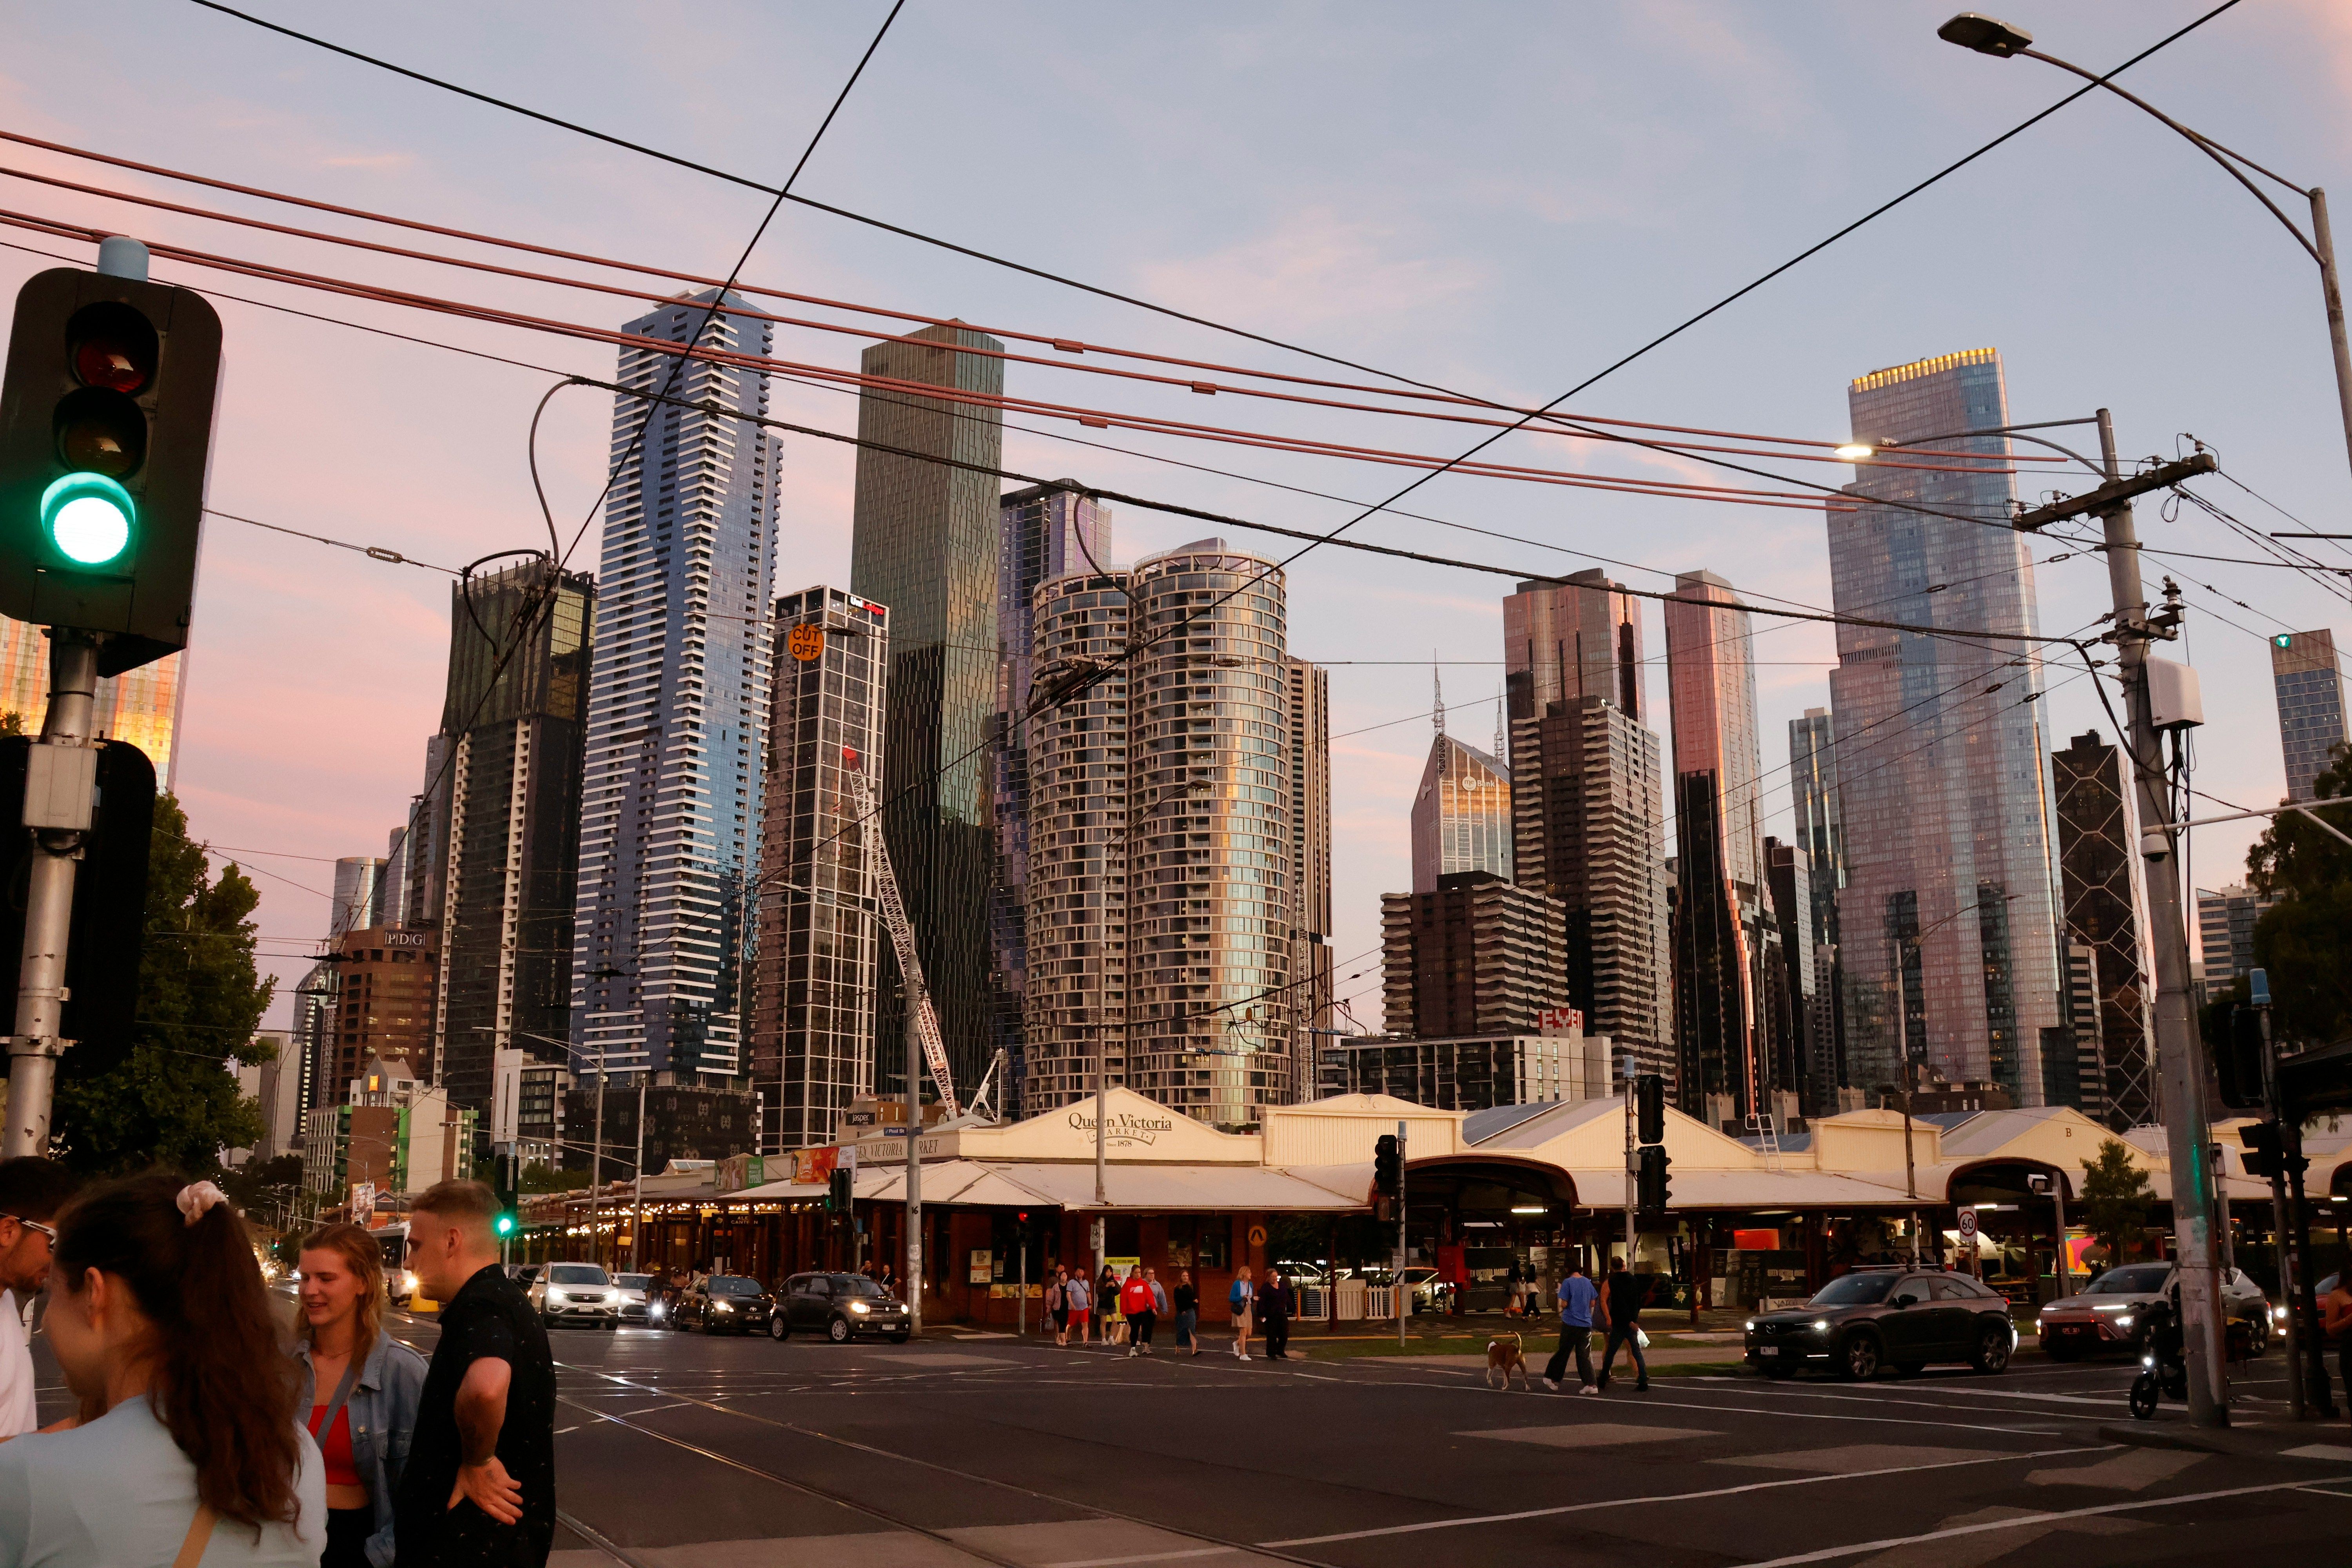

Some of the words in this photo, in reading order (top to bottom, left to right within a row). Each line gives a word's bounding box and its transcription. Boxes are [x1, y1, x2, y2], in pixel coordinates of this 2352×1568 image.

[850, 596, 884, 615] UniLodge
[793, 628, 820, 642] CUT
[793, 643, 818, 656] OFF
[1069, 1112, 1114, 1130] Quen
[1118, 1114, 1172, 1129] Victoria
[1107, 1128, 1146, 1138] ARKET
[2065, 1128, 2072, 1137] B
[871, 1143, 902, 1157] VICTORIA
[919, 1140, 938, 1154] RKET
[1962, 1218, 1973, 1229] 60
